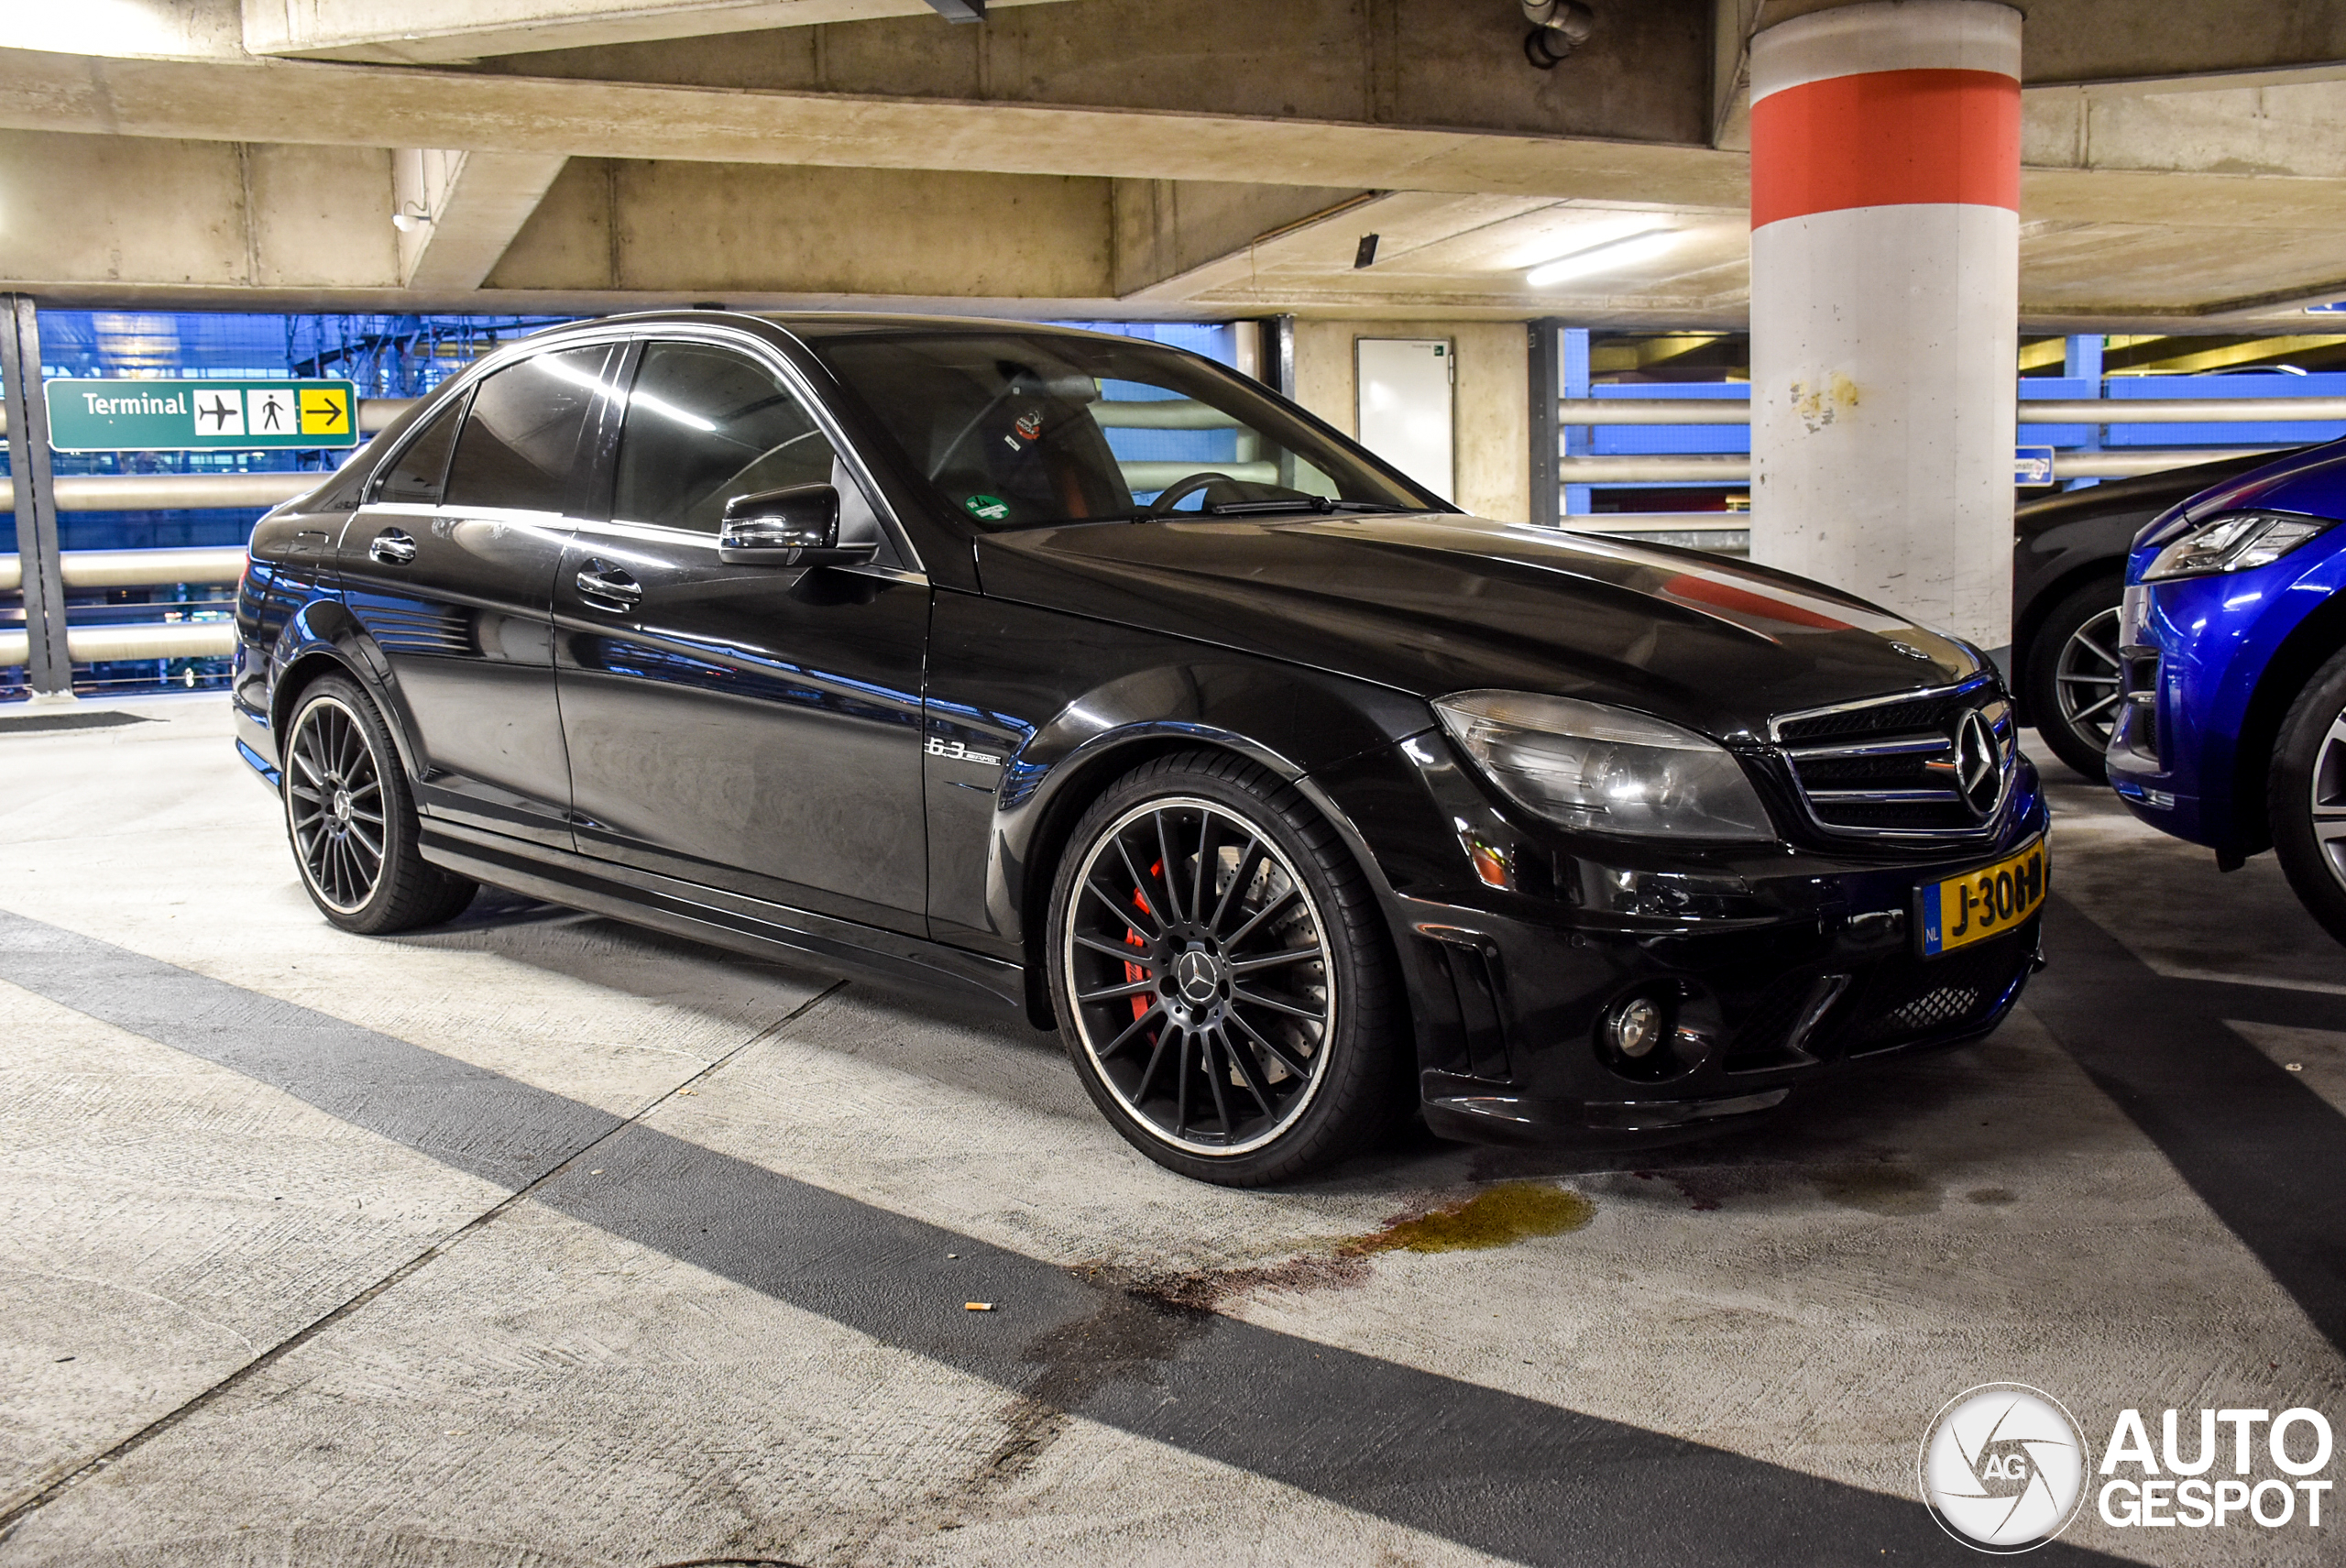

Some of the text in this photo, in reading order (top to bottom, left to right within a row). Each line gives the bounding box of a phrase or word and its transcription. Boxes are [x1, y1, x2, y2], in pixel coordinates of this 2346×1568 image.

[82, 392, 187, 415] Terminal
[974, 496, 991, 508] 4
[929, 737, 965, 759] 63
[1926, 927, 1939, 943] NL
